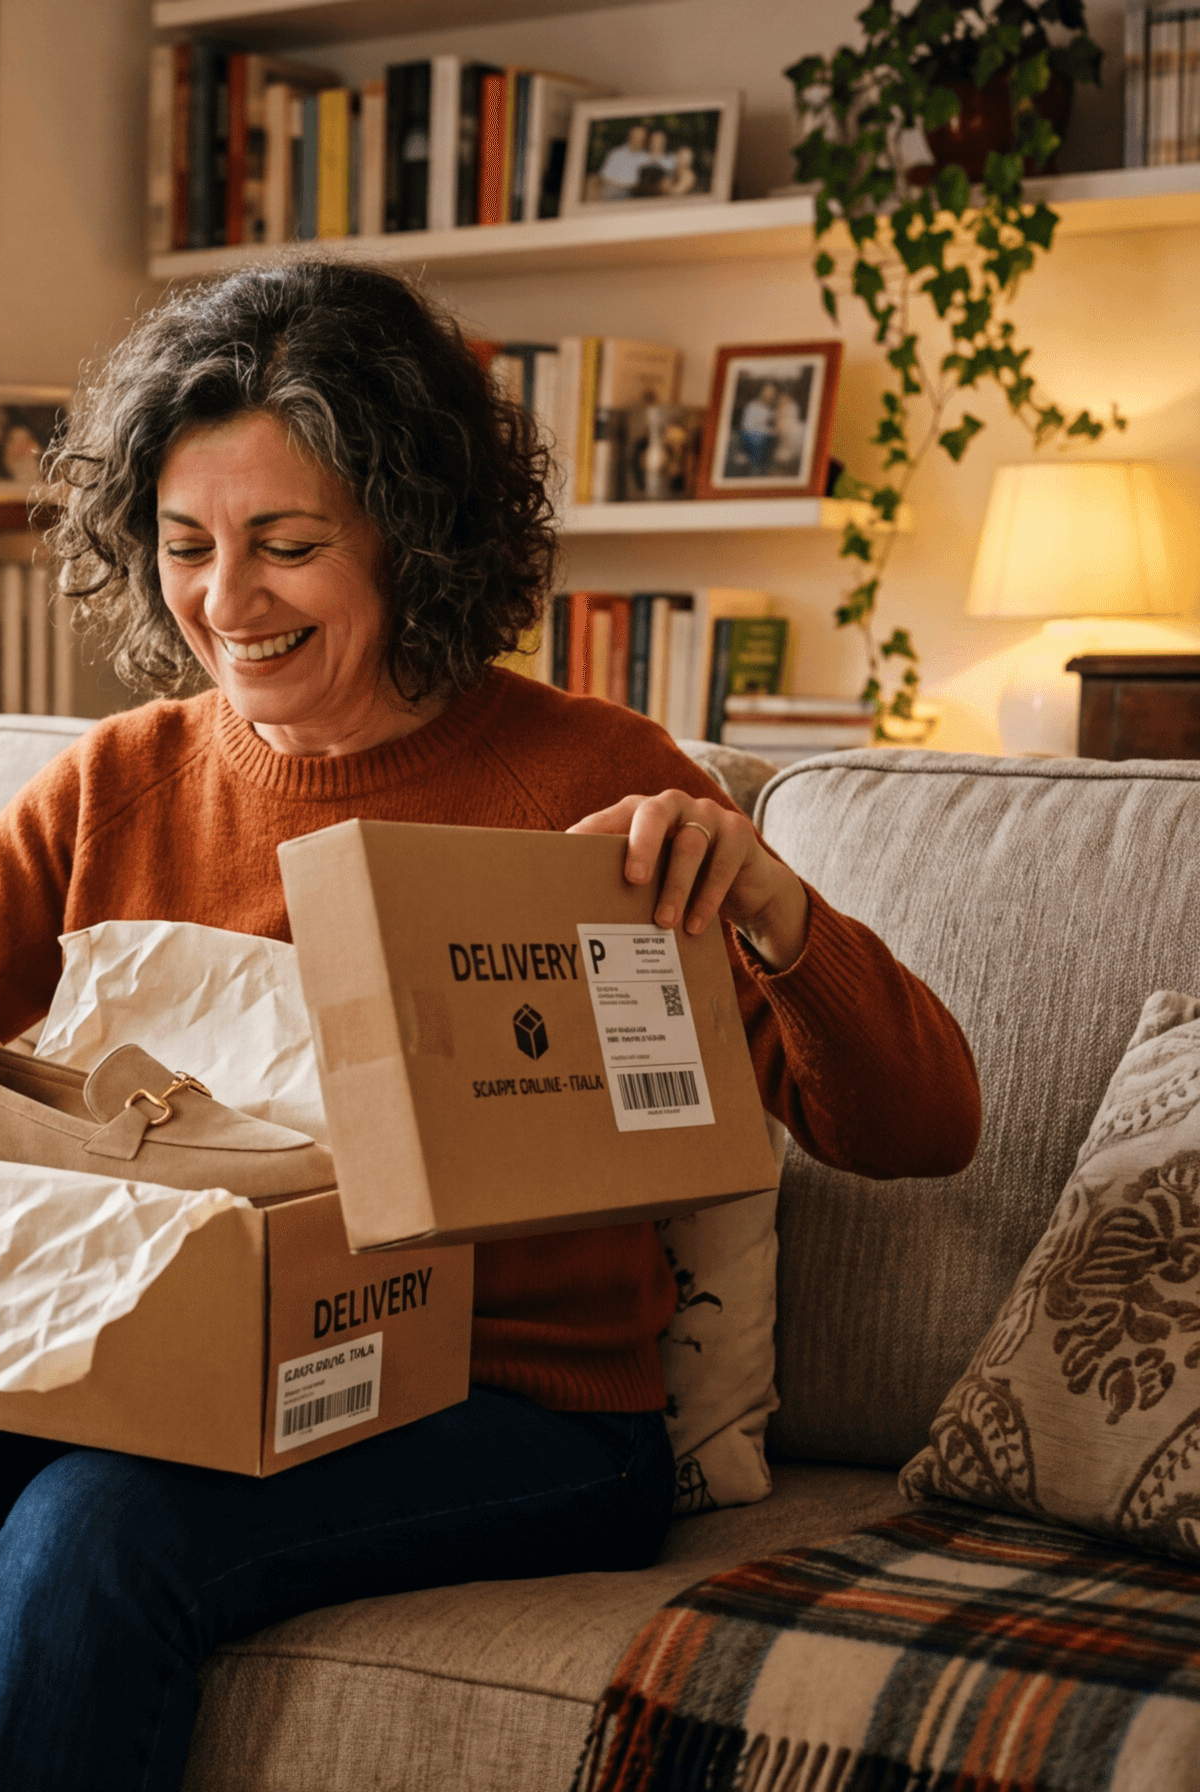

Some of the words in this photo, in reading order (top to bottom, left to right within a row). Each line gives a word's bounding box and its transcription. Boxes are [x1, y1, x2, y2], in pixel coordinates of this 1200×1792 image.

[448, 943, 578, 981] DELIVERY
[588, 939, 606, 975] P
[313, 1266, 433, 1339] DELIVERY
